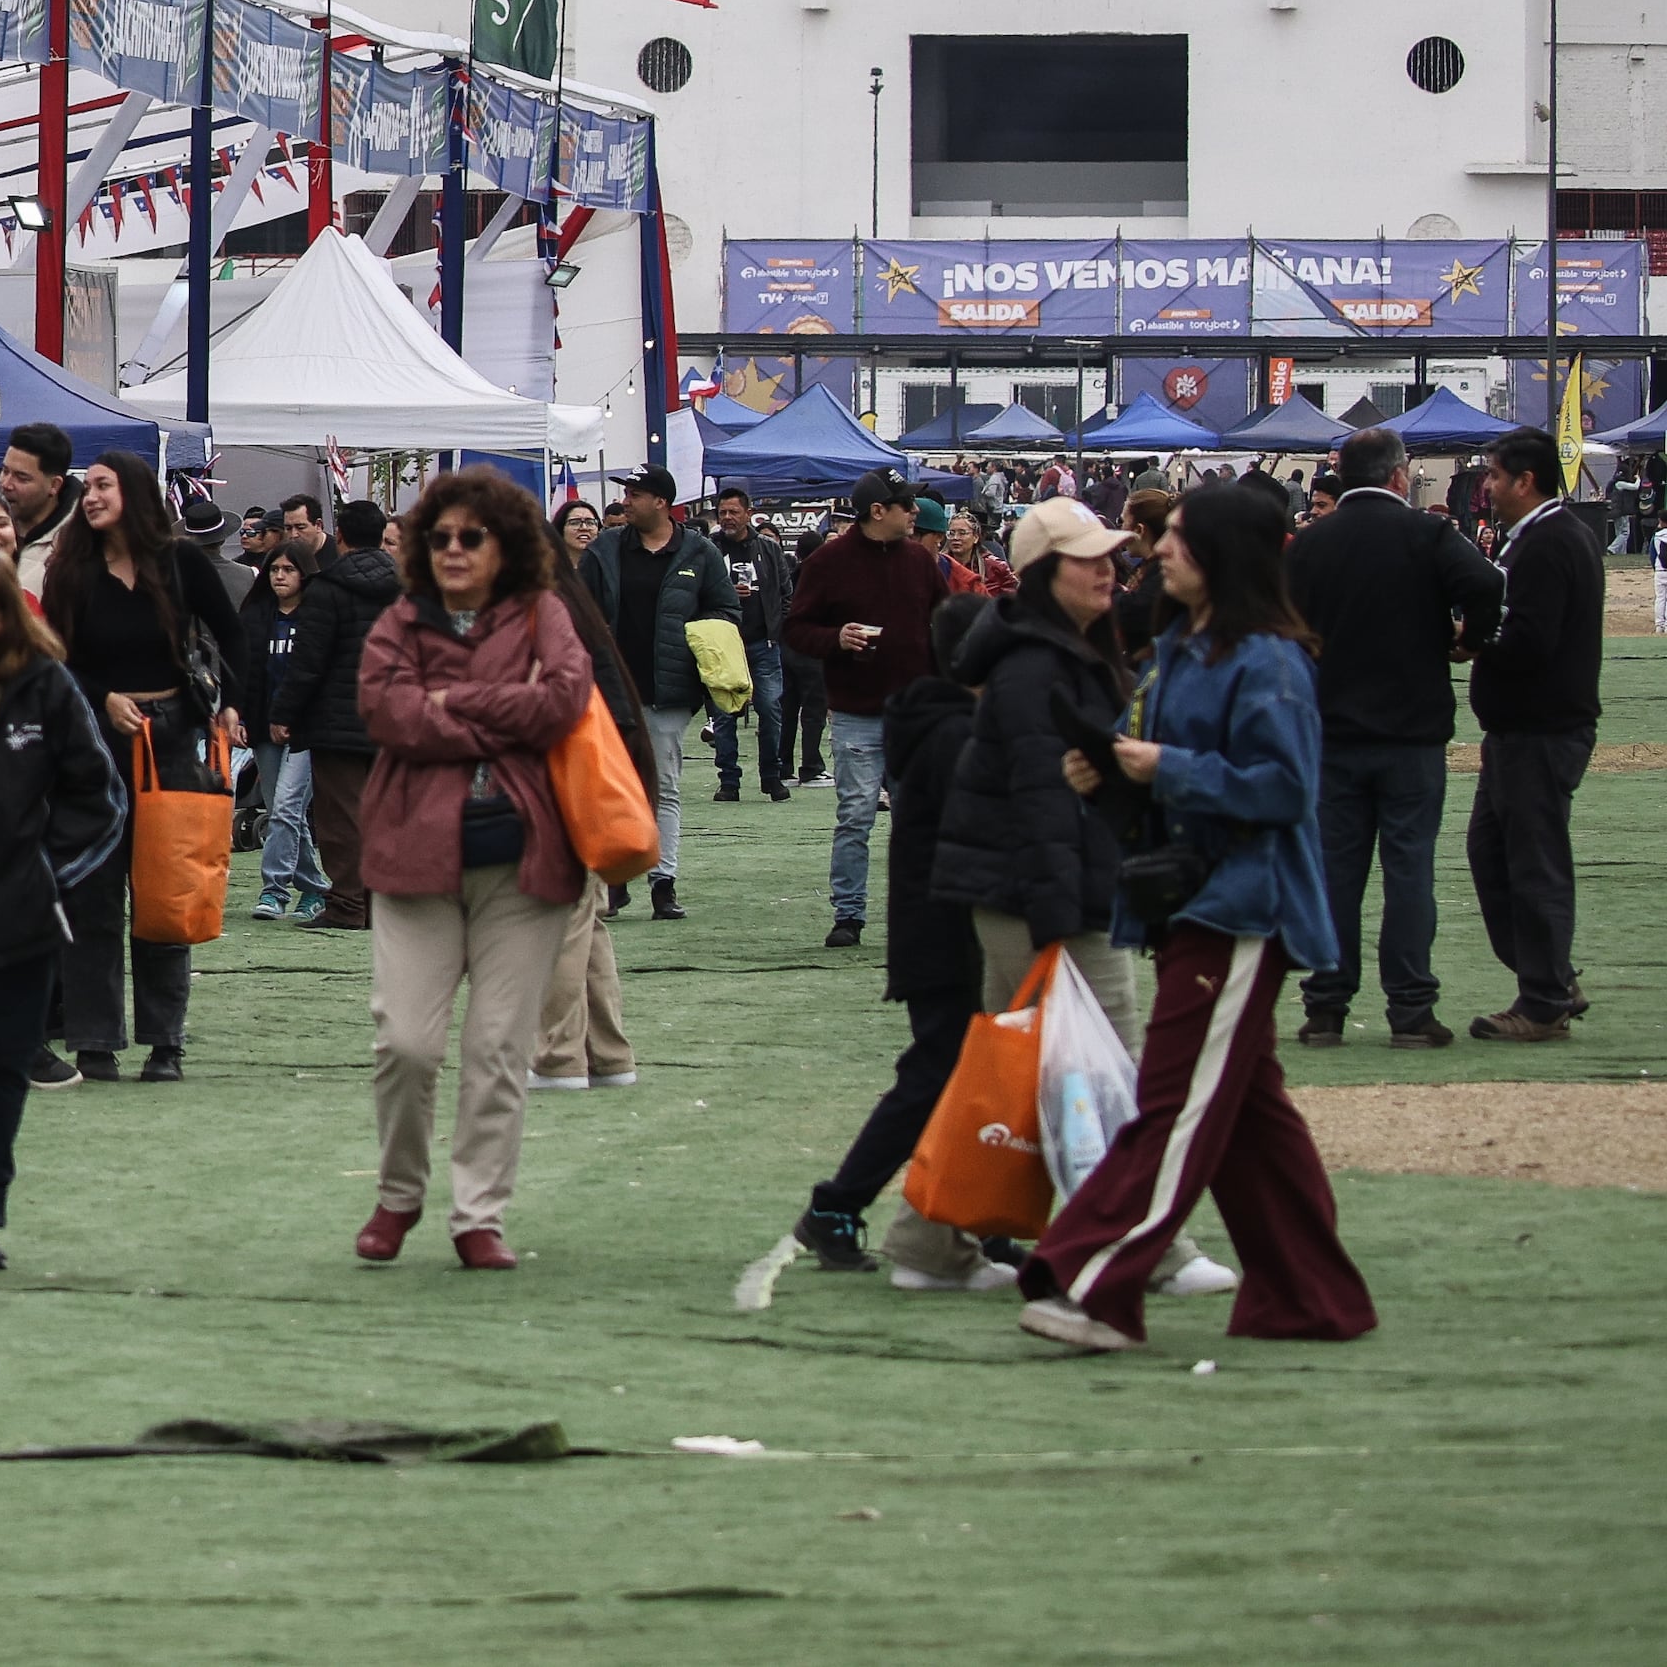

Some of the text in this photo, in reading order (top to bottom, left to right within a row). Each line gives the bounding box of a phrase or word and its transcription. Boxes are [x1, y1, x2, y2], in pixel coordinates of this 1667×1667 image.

[794, 268, 832, 279] tonybet
[942, 257, 1039, 299] ¡NOS
[1043, 257, 1190, 292] VEMOS
[1582, 269, 1620, 280] tonybet
[757, 292, 785, 304] TV+
[948, 303, 1027, 322] SALIDA
[1342, 302, 1419, 322] SALIDA
[1146, 319, 1231, 332] abastible tonybet
[1270, 359, 1289, 405] stible
[750, 510, 821, 529] CAJA
